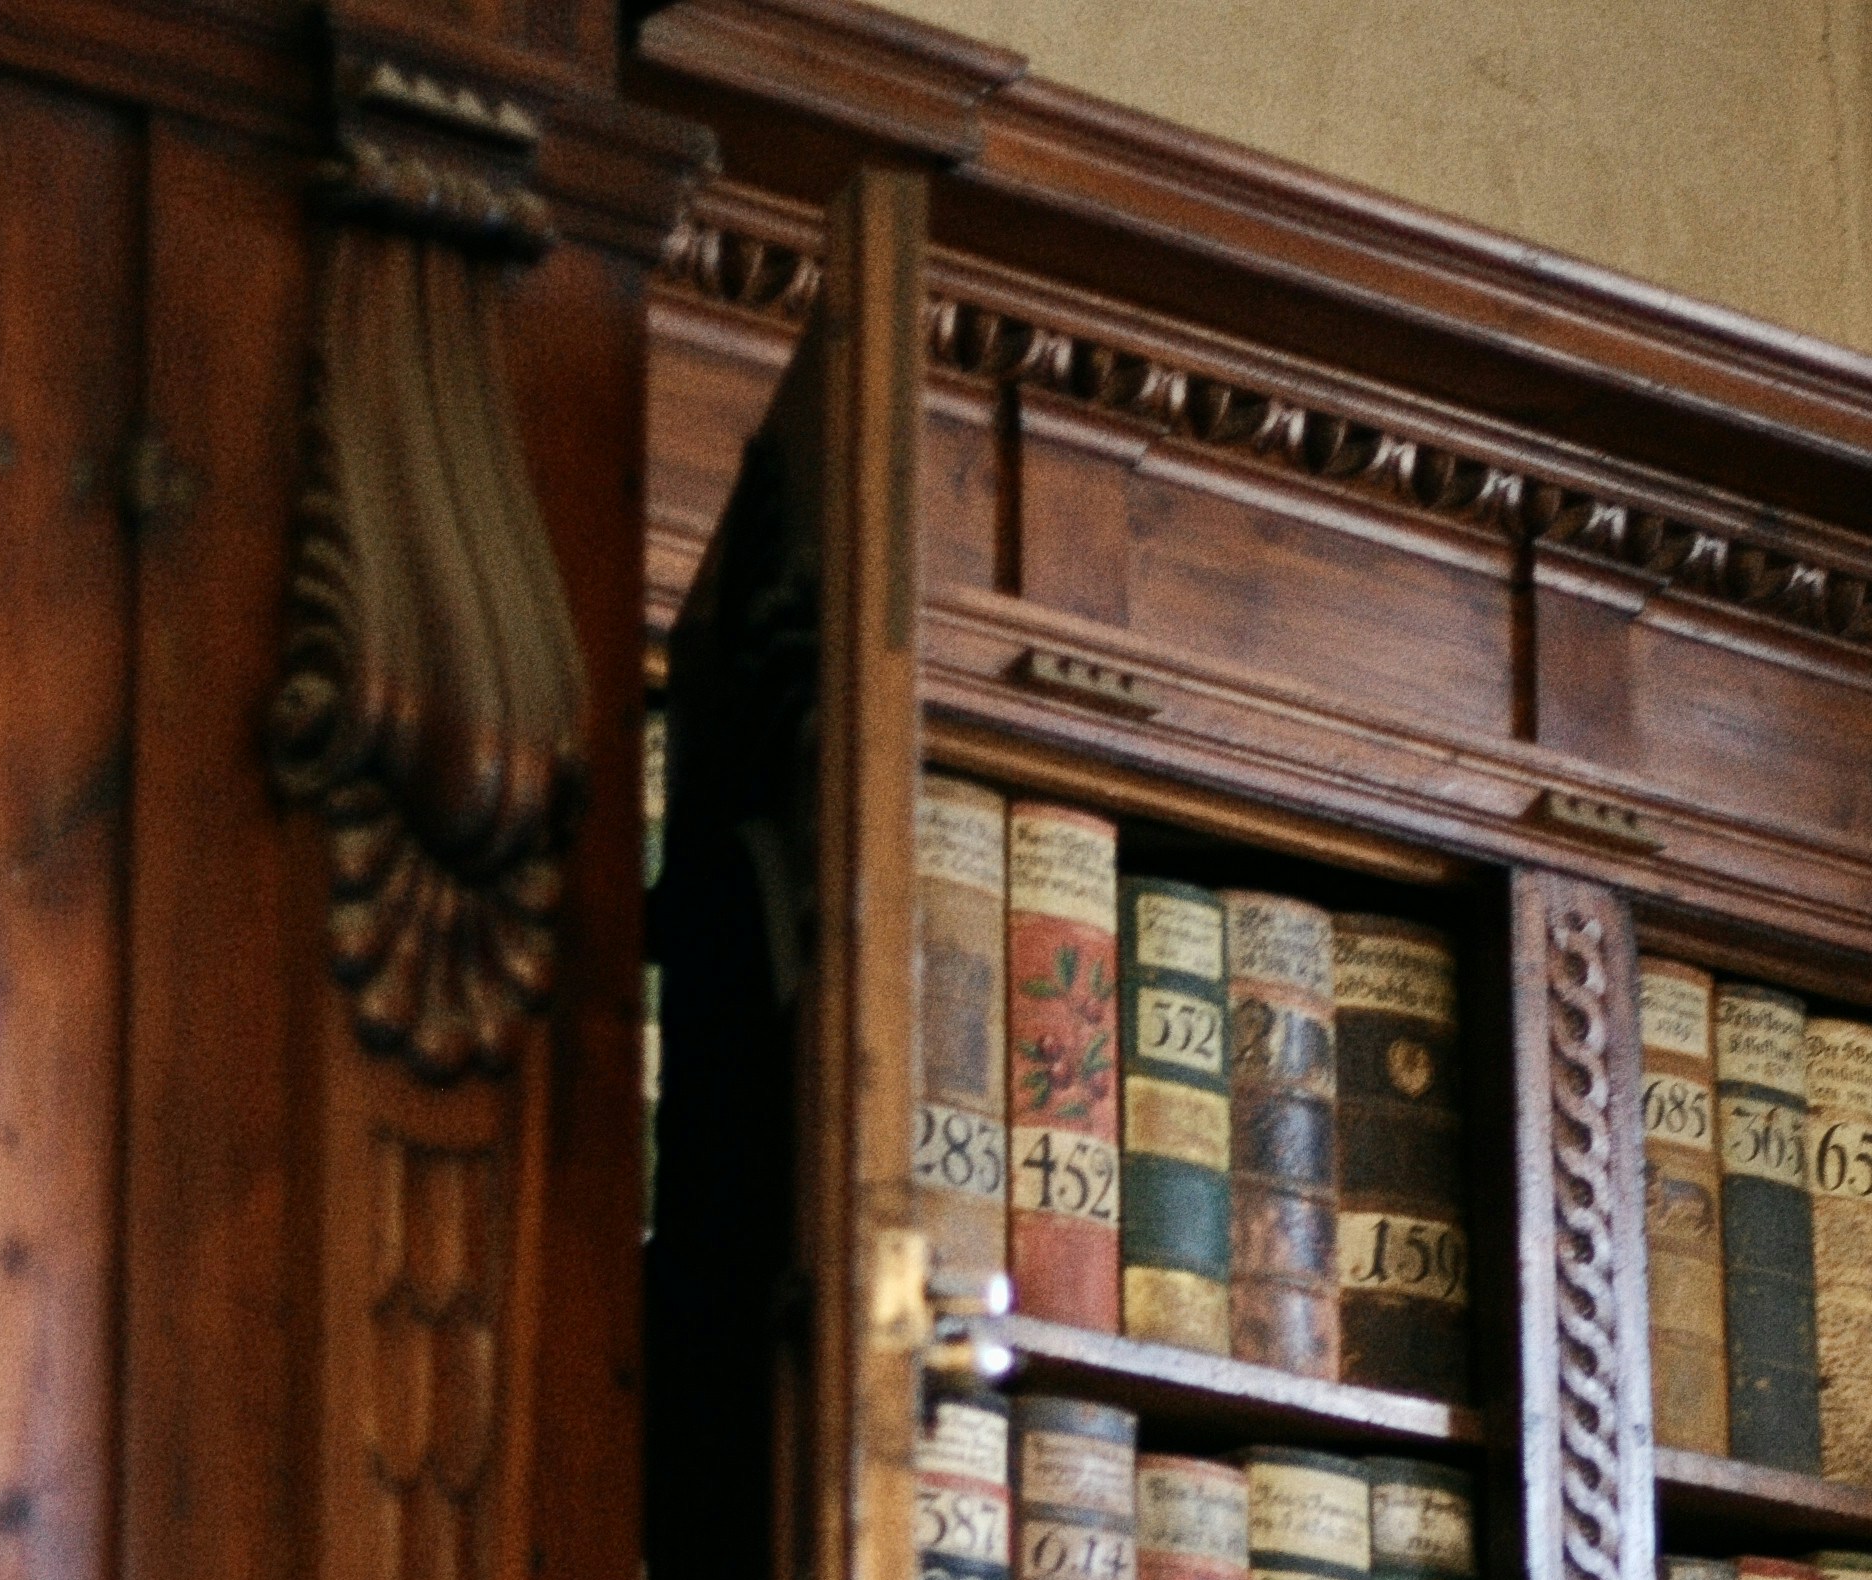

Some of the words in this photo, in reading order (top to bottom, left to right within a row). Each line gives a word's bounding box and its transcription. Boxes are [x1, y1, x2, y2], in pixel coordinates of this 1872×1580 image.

[1642, 1080, 1707, 1138] 685
[1021, 1132, 1114, 1219] 452
[1350, 1218, 1464, 1298] 159
